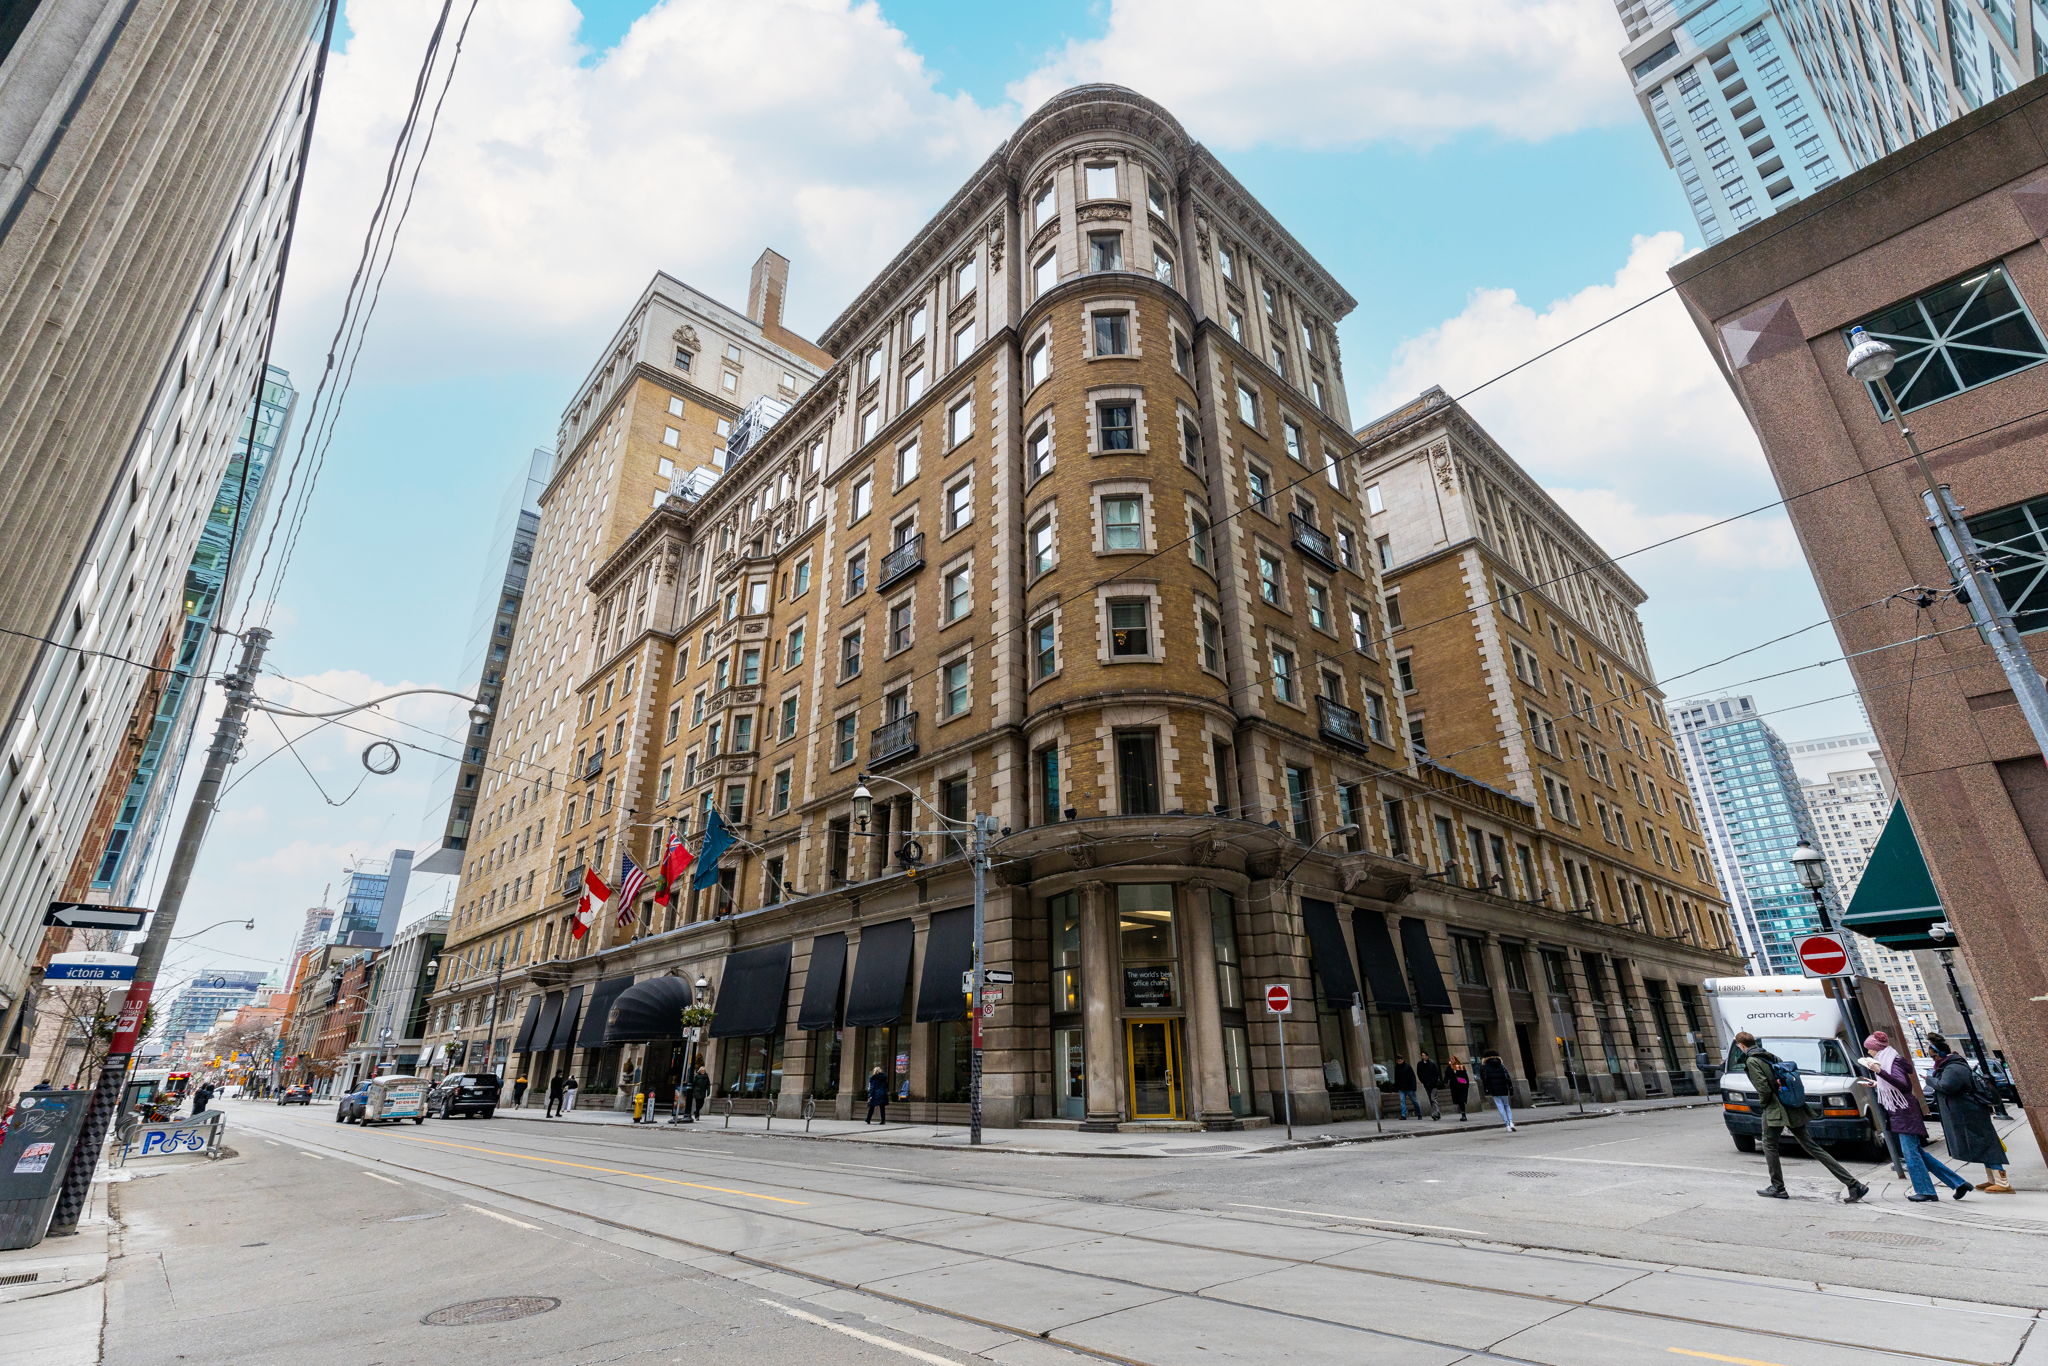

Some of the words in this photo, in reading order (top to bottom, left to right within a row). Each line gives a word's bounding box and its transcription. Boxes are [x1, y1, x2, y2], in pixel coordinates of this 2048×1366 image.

[110, 970, 120, 978] St
[1746, 1011, 1795, 1019] aramark
[141, 1130, 166, 1155] P
